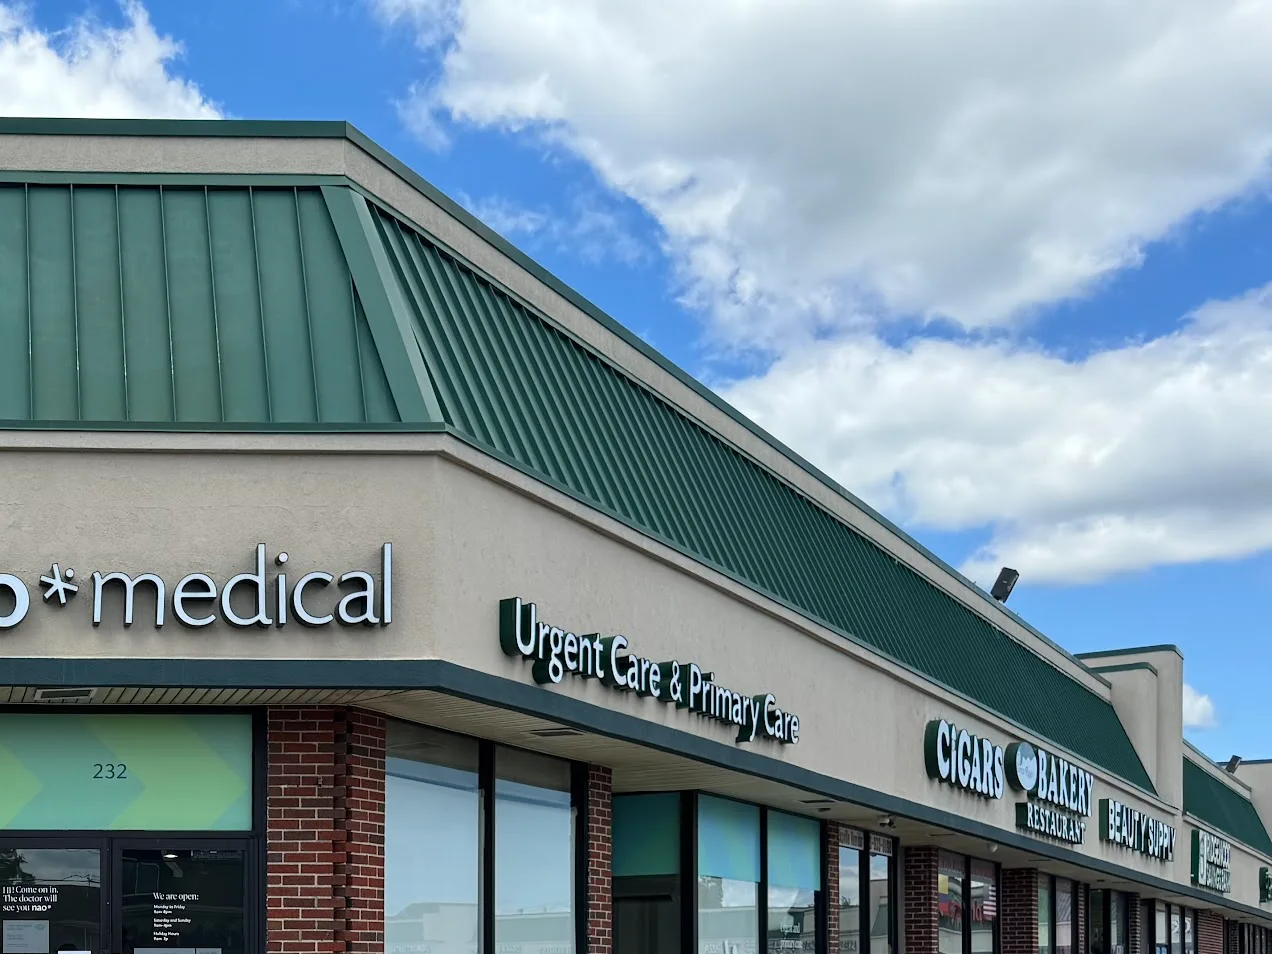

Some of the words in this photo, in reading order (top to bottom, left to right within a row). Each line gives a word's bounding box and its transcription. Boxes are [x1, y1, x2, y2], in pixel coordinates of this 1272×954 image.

[90, 541, 393, 629] medical
[514, 596, 605, 684] Urgent
[610, 634, 662, 698] Care
[669, 660, 684, 703] &
[689, 662, 761, 743] Primary
[762, 692, 801, 744] Care
[92, 763, 127, 779] 232
[1037, 749, 1095, 818] BAKERY
[1027, 802, 1086, 845] RESTAURANT
[1108, 798, 1148, 853] BEAUTY
[1147, 816, 1177, 862] SUPPLY
[2, 894, 18, 903] The
[18, 894, 43, 903] doctor
[43, 894, 58, 903] will
[15, 885, 37, 894] Come
[49, 885, 59, 894] in.
[152, 892, 165, 900] We
[178, 893, 199, 902] open:
[15, 904, 30, 913] you
